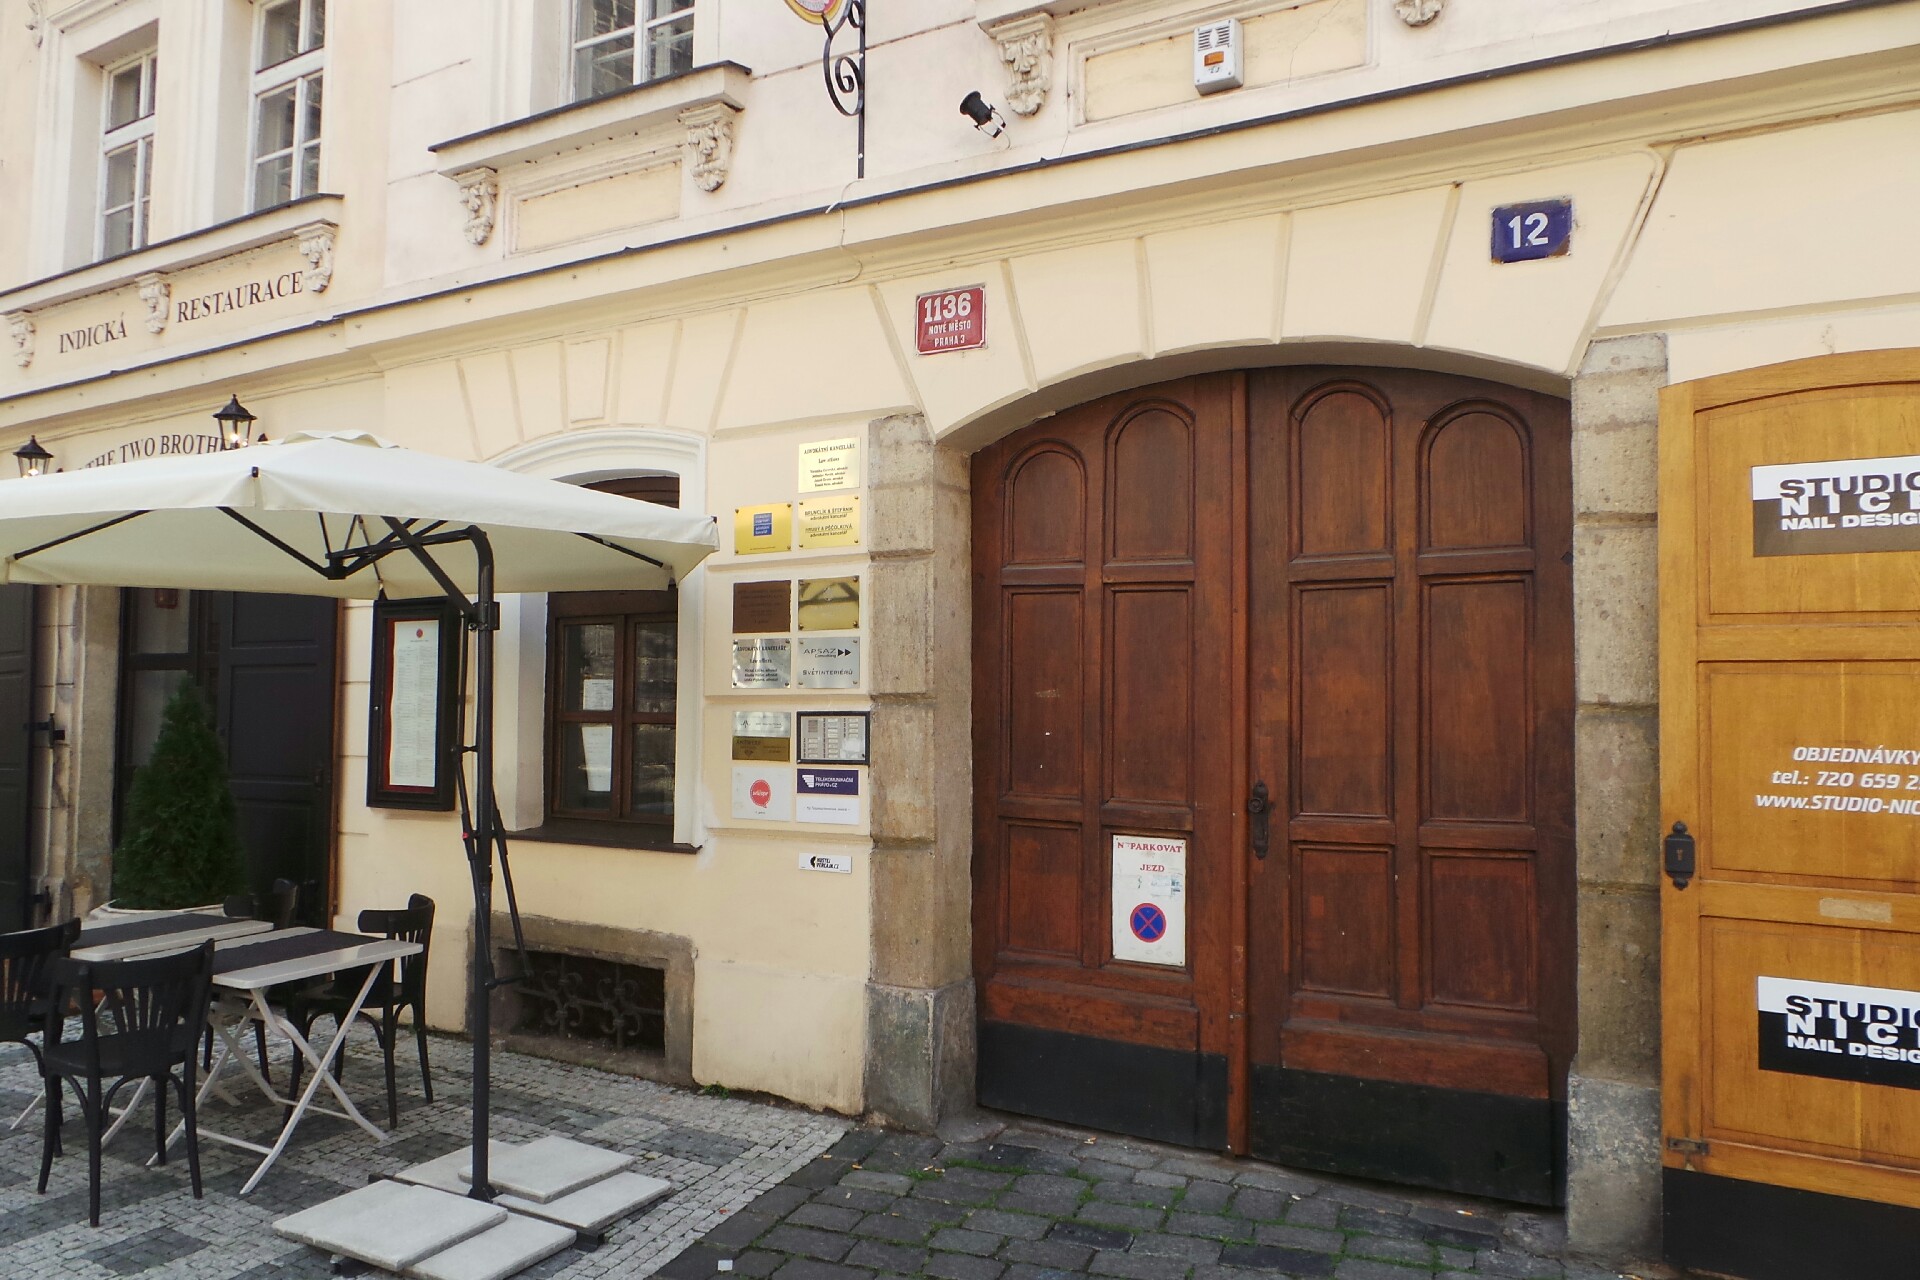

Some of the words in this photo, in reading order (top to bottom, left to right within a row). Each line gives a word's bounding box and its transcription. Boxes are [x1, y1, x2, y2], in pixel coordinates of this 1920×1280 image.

[1508, 212, 1548, 248] 12
[59, 311, 128, 354] INDICKÁ
[176, 271, 303, 323] RESTAURACE
[924, 292, 971, 323] 1136
[928, 321, 947, 335] NOVÉ
[949, 320, 971, 332] MĚSTO
[934, 335, 959, 347] PRAHA
[120, 437, 155, 463] TWO
[1781, 515, 1836, 531] NAIL
[1793, 745, 1920, 765] OBJEDNÁVKY
[1772, 770, 1810, 785] tel.:
[1816, 771, 1854, 787] 720
[1860, 773, 1901, 789] 659
[1905, 775, 1920, 790] 2
[1787, 1035, 1843, 1054] NAIL
